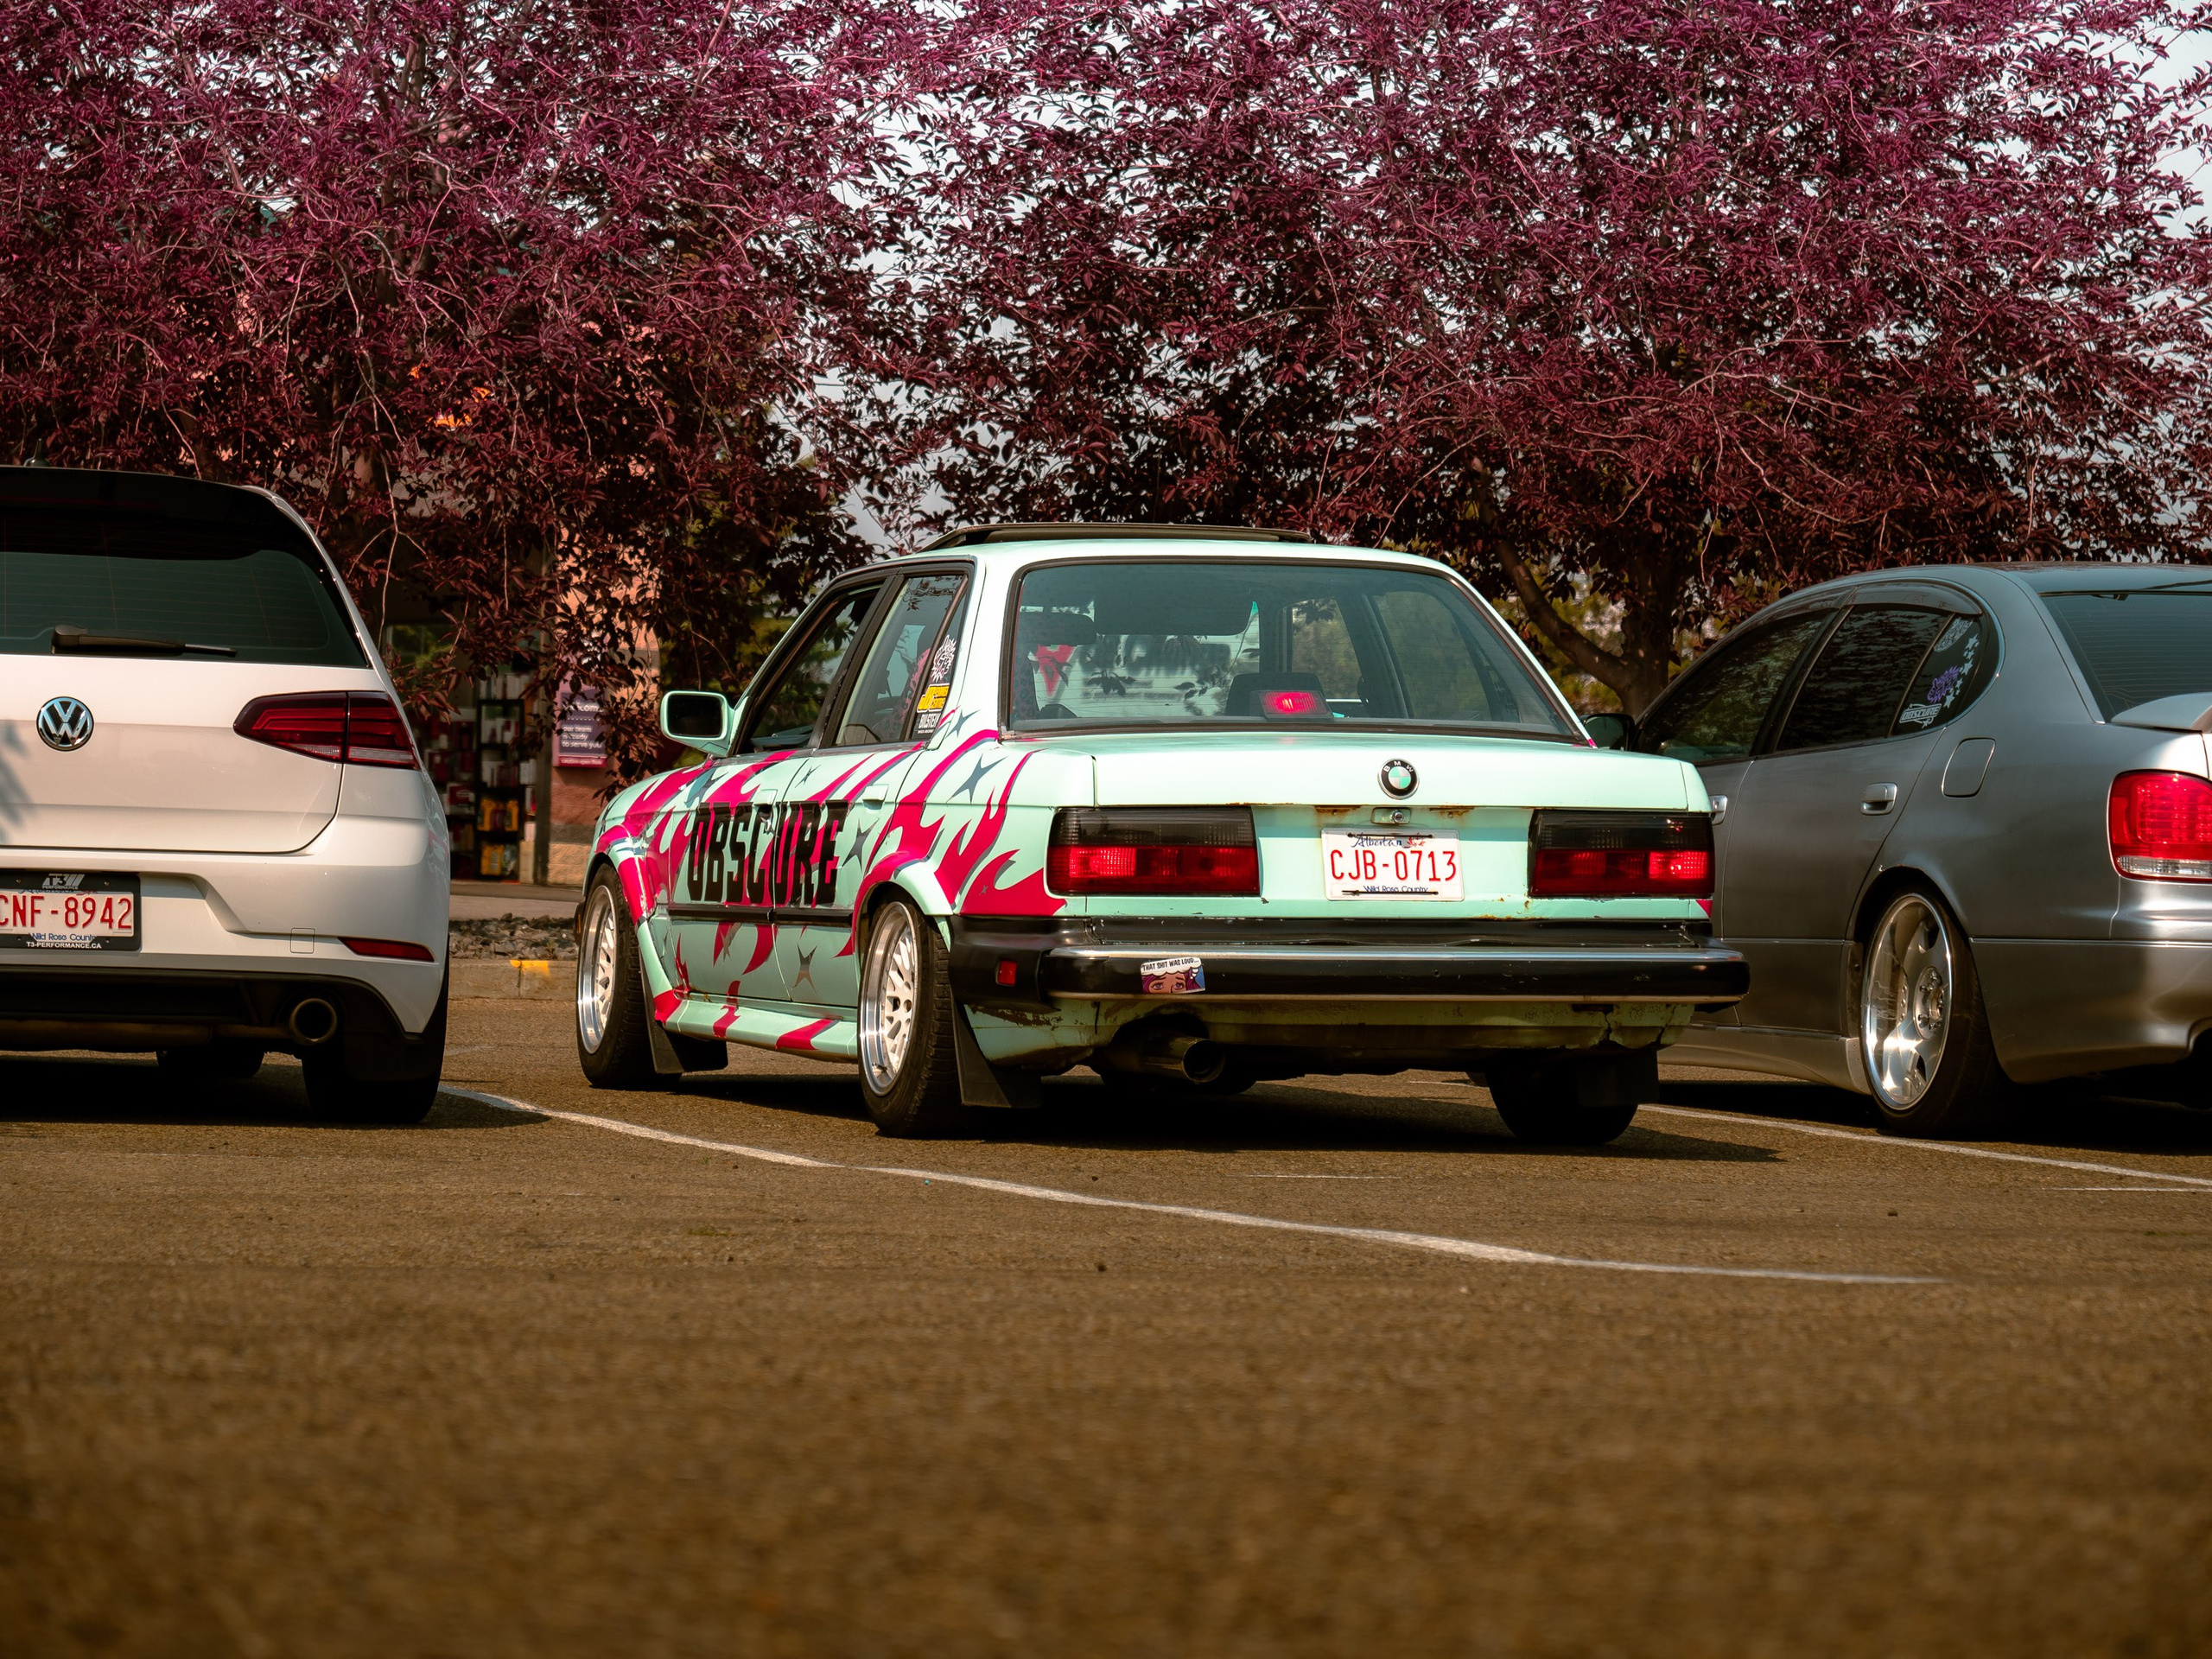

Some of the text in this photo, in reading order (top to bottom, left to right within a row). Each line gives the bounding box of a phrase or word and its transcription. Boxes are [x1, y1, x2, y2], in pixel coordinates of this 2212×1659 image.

[1902, 706, 1940, 721] OBSCURE
[1382, 760, 1414, 772] BMW
[1351, 832, 1395, 848] Alberta
[687, 799, 849, 906] OBSCURE
[1330, 849, 1457, 881] CJB-0713
[0, 894, 131, 929] CNF-8942
